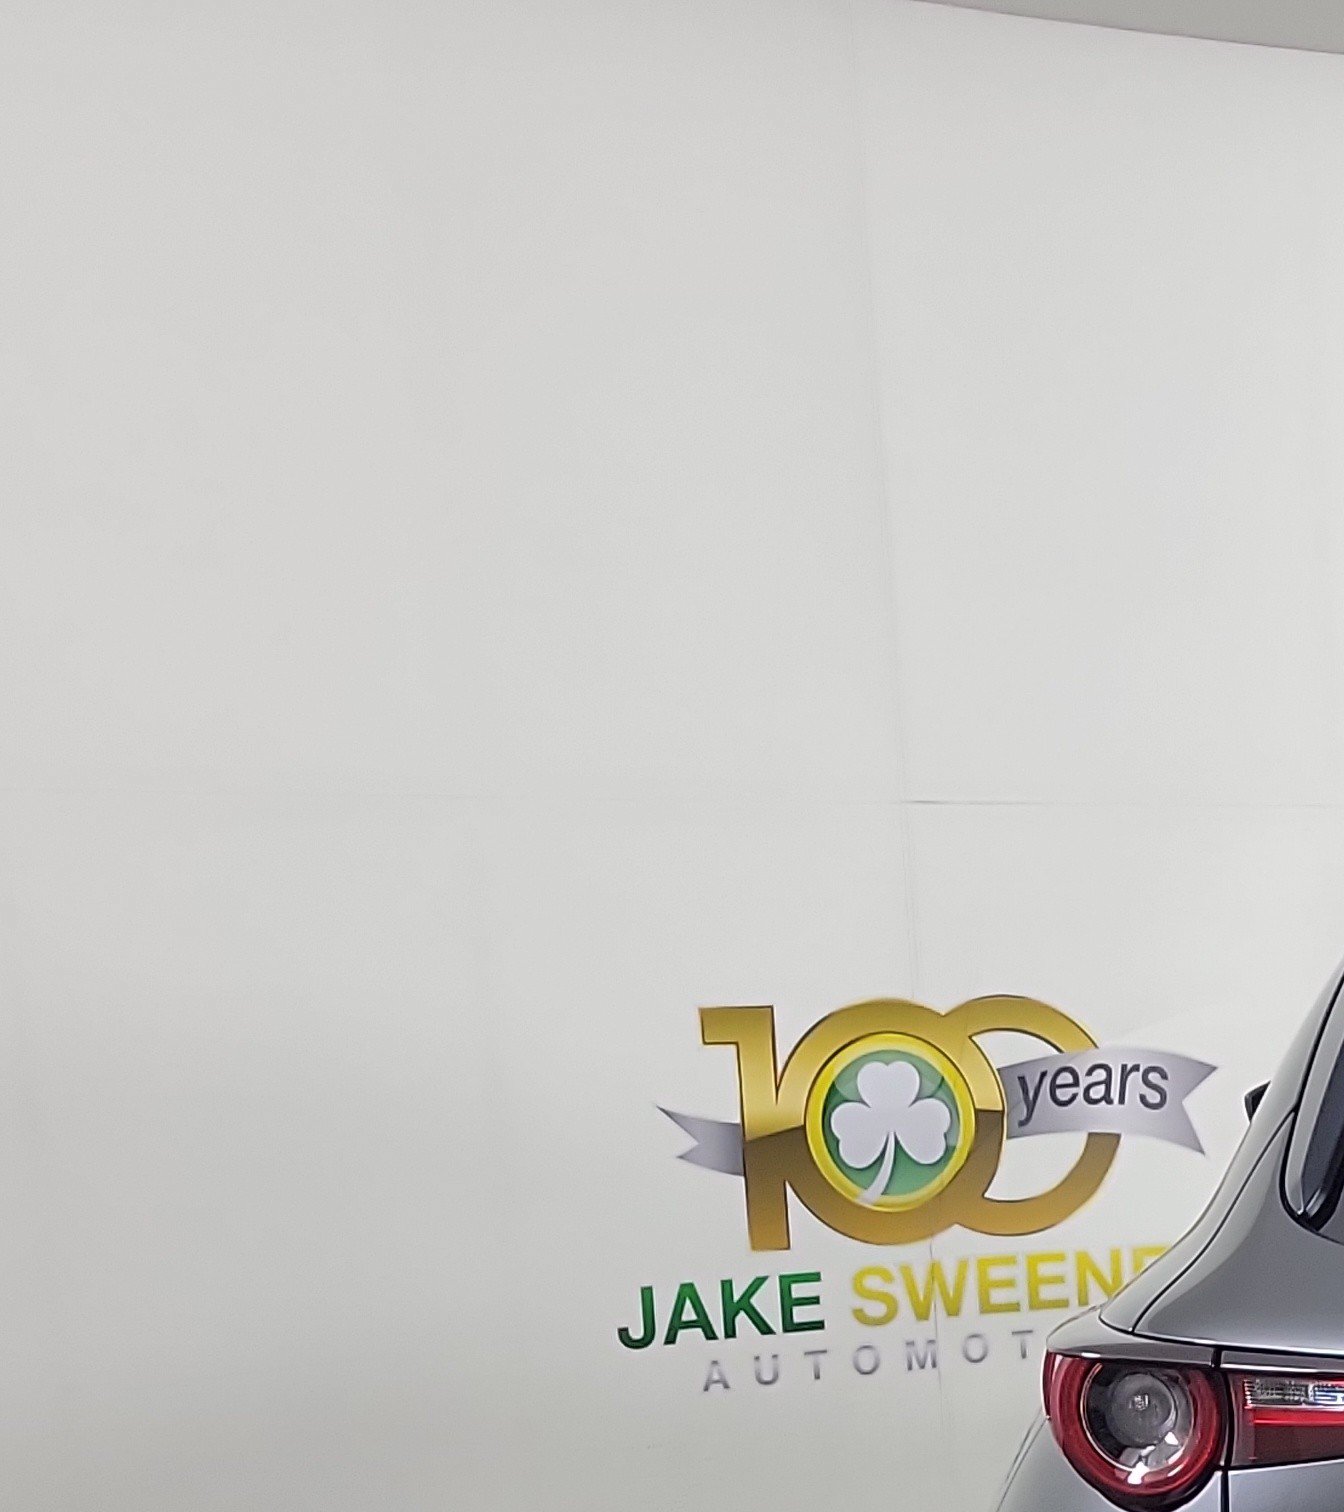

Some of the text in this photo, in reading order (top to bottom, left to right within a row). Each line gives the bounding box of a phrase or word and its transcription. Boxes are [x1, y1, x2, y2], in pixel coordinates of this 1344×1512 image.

[1017, 1061, 1169, 1126] years
[617, 1270, 827, 1350] JAKE
[702, 1328, 1036, 1392] AUTOMOT
